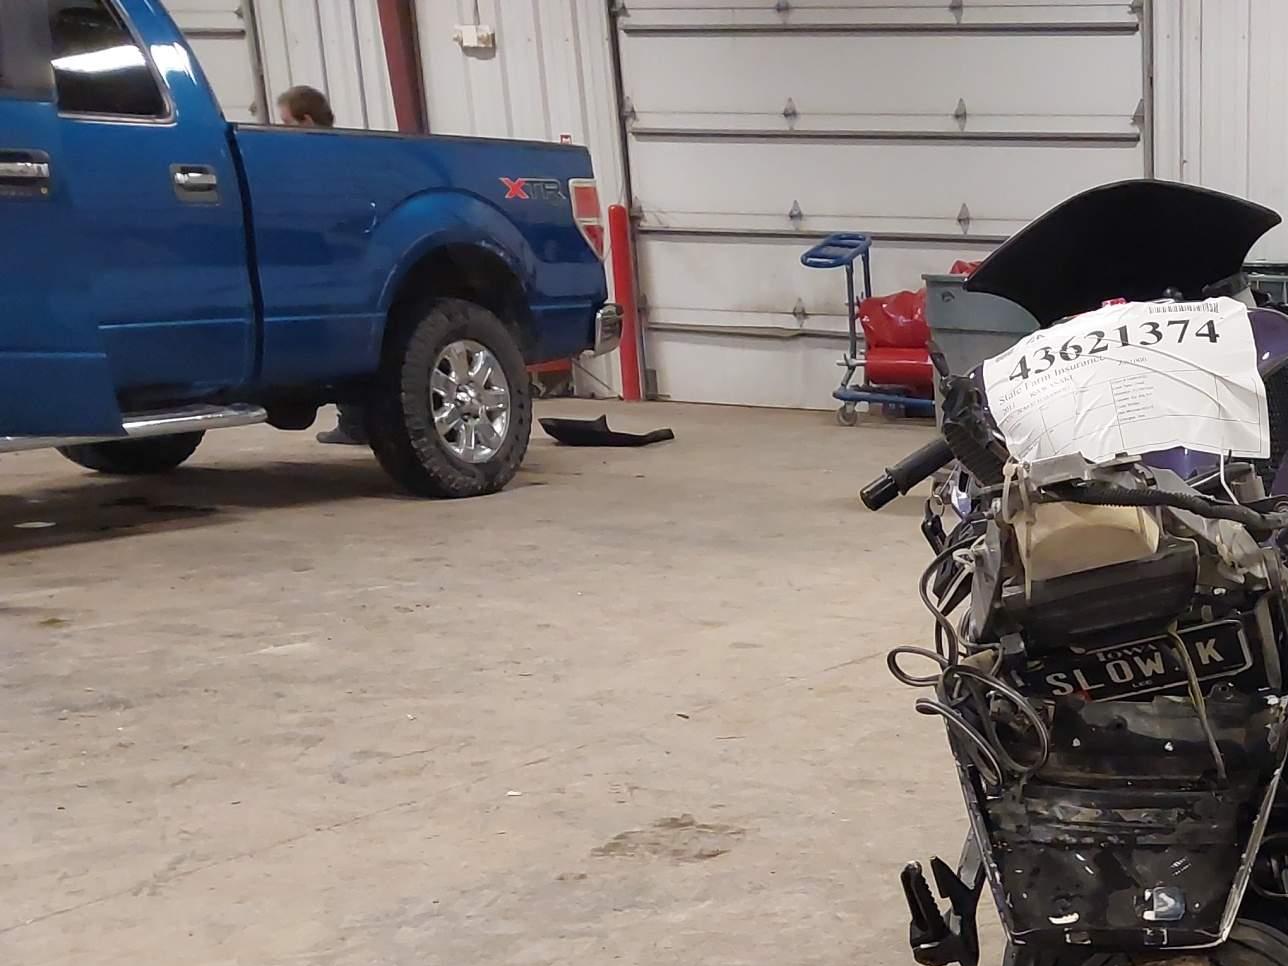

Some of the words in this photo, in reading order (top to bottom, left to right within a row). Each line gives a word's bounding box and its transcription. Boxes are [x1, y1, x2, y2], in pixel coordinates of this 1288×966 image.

[498, 177, 567, 200] XTR
[1008, 319, 1221, 382] 43621374
[998, 385, 1023, 405] State
[1024, 373, 1051, 391] Farm
[1095, 643, 1158, 663] IOWA
